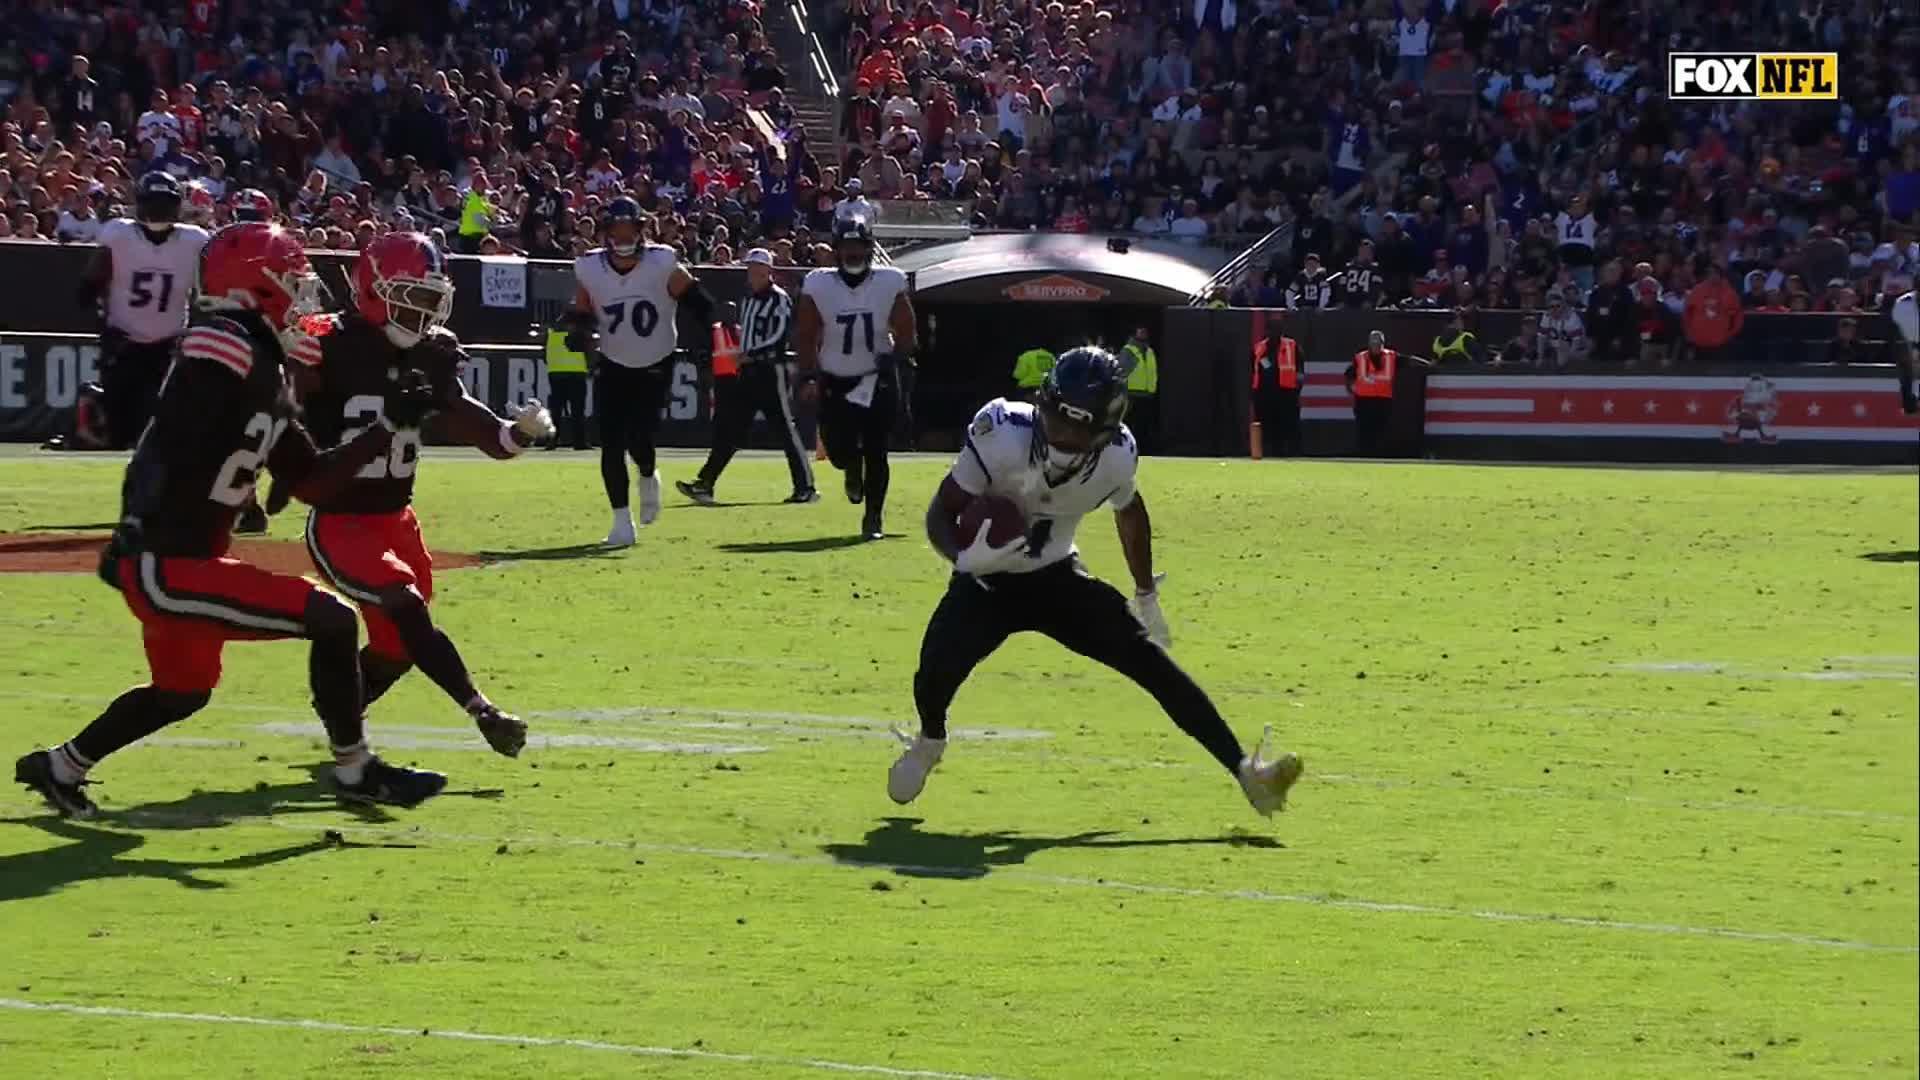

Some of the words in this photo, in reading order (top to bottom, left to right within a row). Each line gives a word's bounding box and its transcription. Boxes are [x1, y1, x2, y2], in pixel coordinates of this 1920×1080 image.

[129, 271, 174, 313] 51
[1346, 269, 1371, 293] 24
[601, 300, 658, 337] 70
[836, 312, 875, 355] 71
